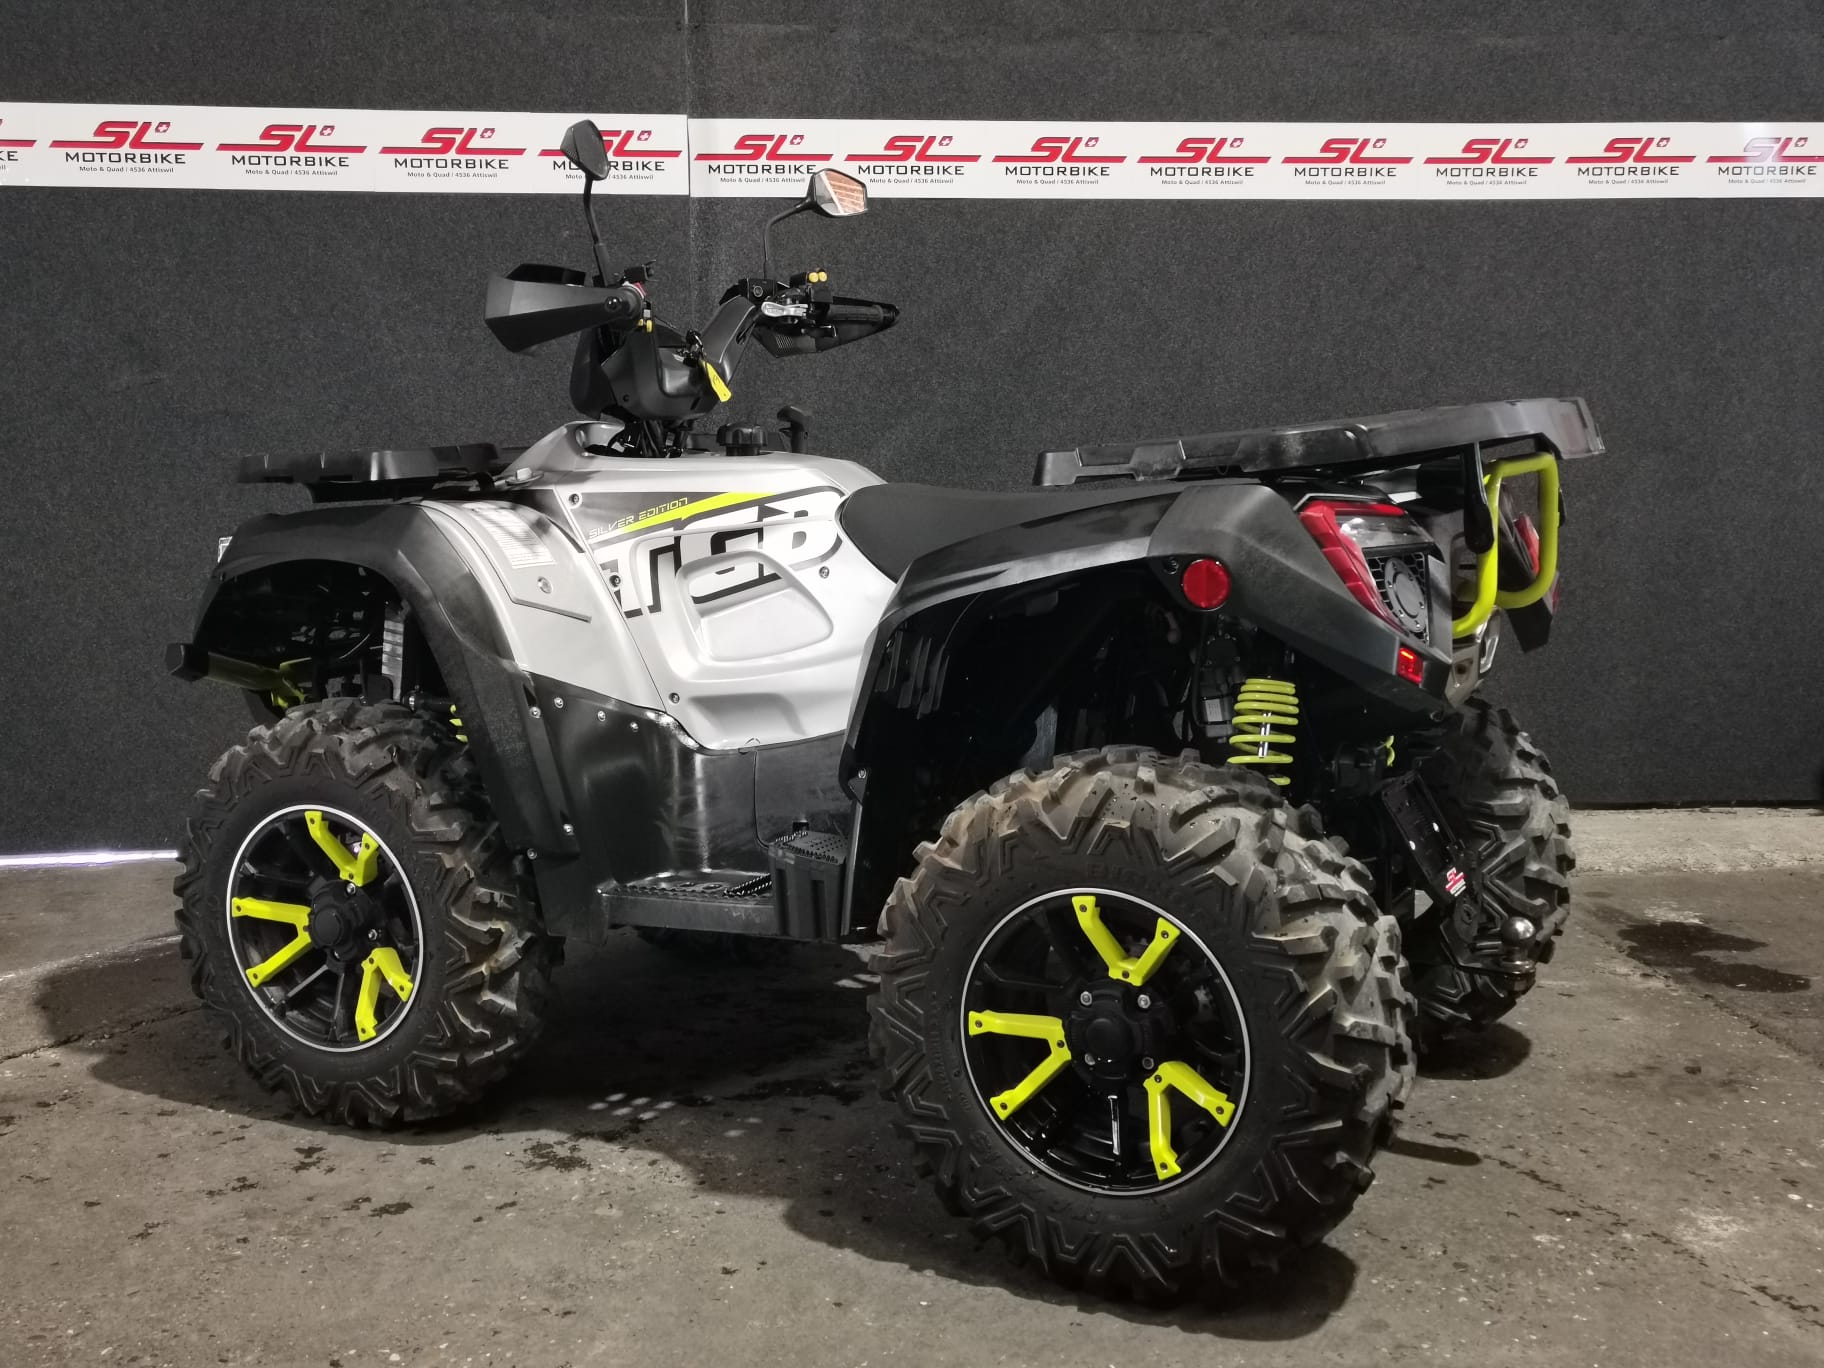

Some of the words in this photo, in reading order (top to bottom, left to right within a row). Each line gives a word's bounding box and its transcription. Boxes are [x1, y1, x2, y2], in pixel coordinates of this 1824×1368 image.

[66, 152, 185, 164] MOTORBIKE
[232, 155, 349, 167] MOTORBIKE
[395, 158, 508, 169] MOTORBIKE
[708, 164, 816, 174] MOTORBIKE
[858, 165, 964, 175] MOTORBIKE
[1006, 166, 1110, 176] MOTORBIKE
[1151, 167, 1254, 176] MOTORBIKE
[1295, 168, 1396, 176] MOTORBIKE
[1437, 168, 1538, 177] MOTORBIKE
[1578, 166, 1679, 176] MOTORBIKE
[1718, 166, 1816, 175] MOTORBIKE
[589, 514, 634, 539] SILVER
[638, 497, 688, 520] EDITION
